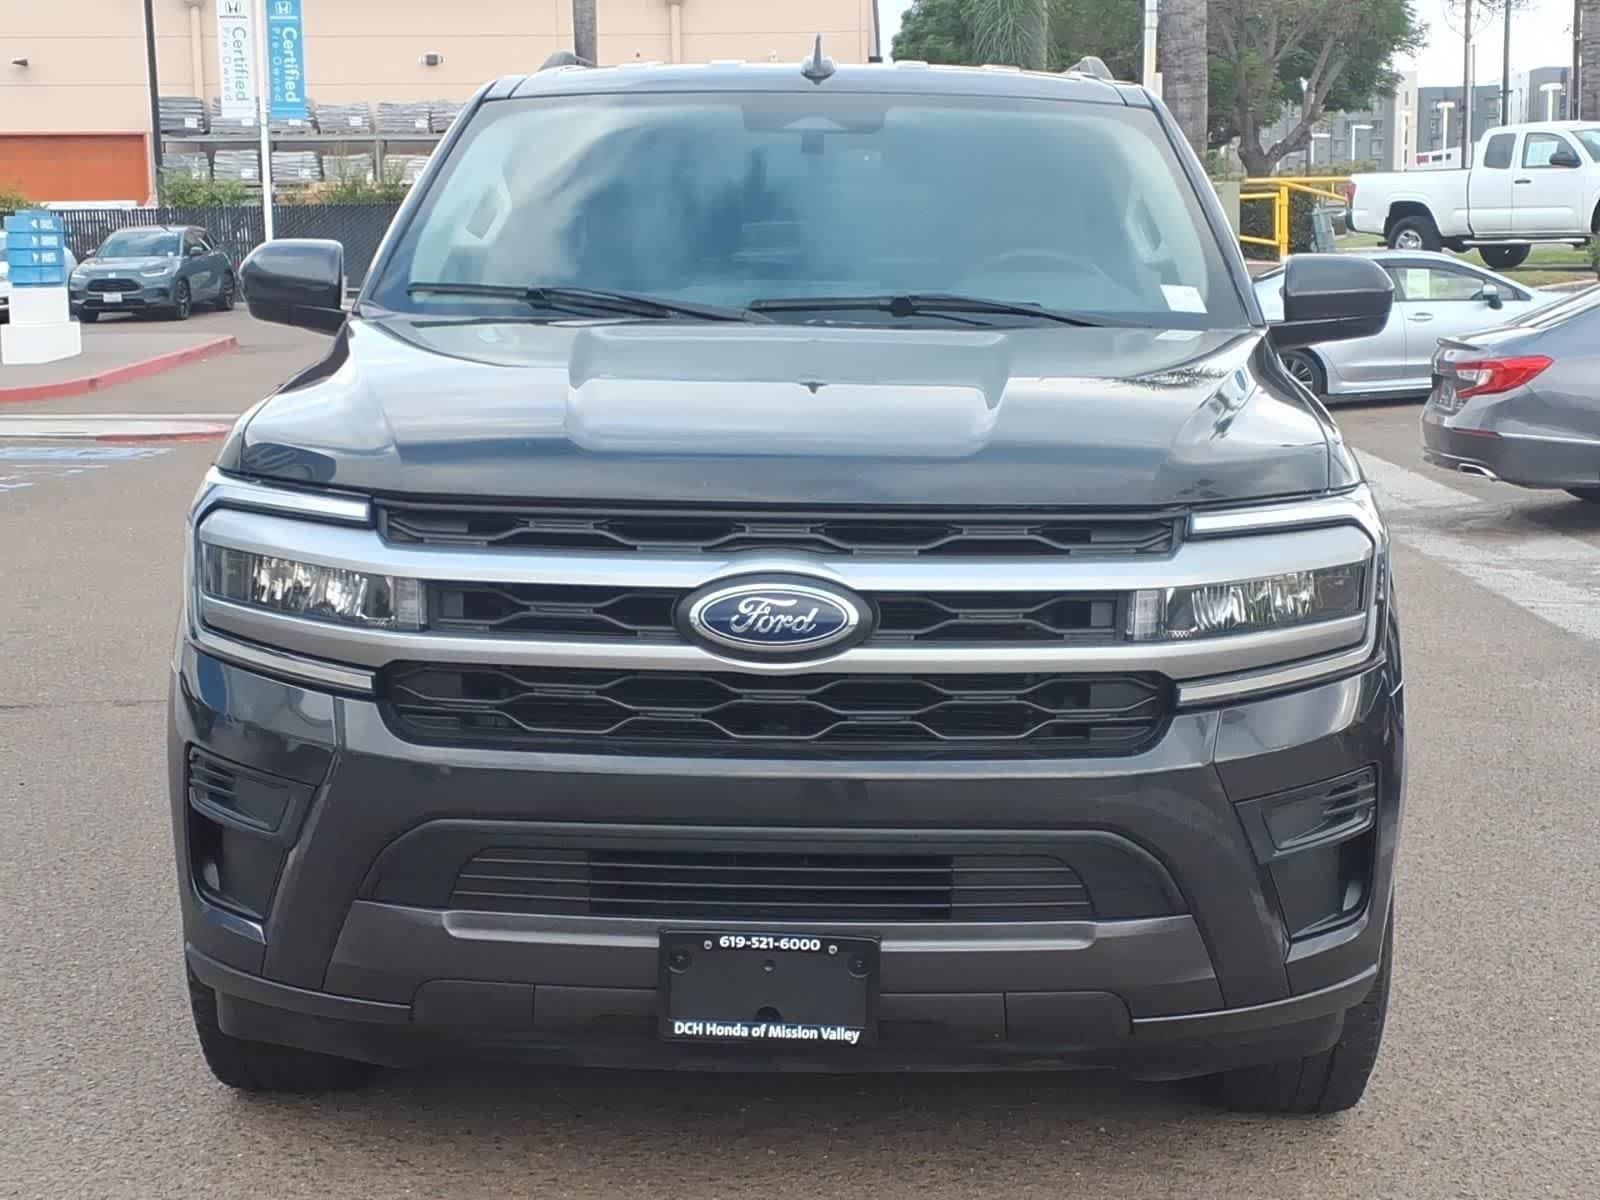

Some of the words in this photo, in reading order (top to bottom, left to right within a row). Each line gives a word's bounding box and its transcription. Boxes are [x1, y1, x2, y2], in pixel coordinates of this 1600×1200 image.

[232, 26, 250, 101] Certified
[281, 27, 301, 102] Certified
[729, 596, 820, 634] Ford
[719, 936, 821, 951] 619-521-6000
[674, 1021, 703, 1036] DCH
[706, 1023, 749, 1038] Honda
[751, 1024, 766, 1038] of
[768, 1025, 818, 1041] Mission
[821, 1027, 860, 1045] Valley
